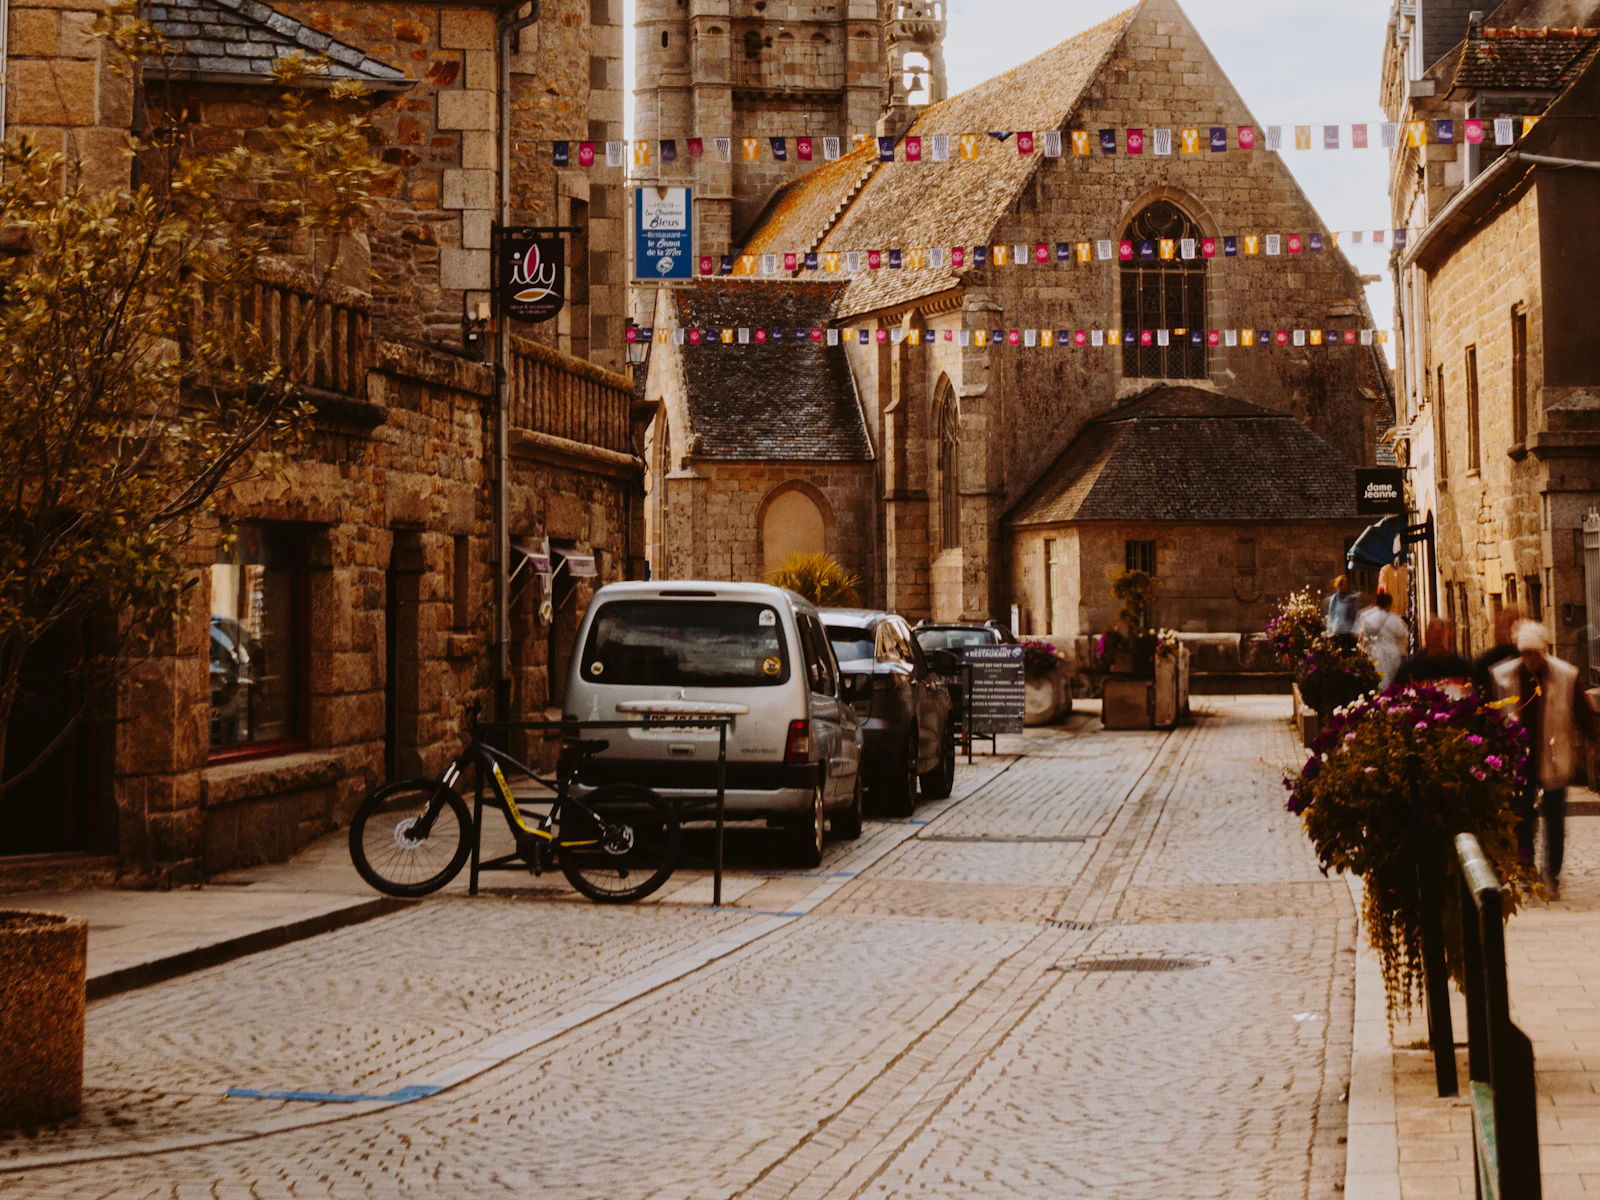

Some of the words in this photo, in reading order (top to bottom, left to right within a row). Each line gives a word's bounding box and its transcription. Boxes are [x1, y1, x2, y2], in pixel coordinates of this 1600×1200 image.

[655, 208, 683, 216] Chardons
[649, 215, 679, 228] Bleus
[656, 238, 680, 248] Bistrot
[665, 248, 682, 257] Mer
[1366, 482, 1393, 491] dame
[1363, 490, 1398, 499] Jeanne
[970, 650, 1011, 658] RESTAURANT
